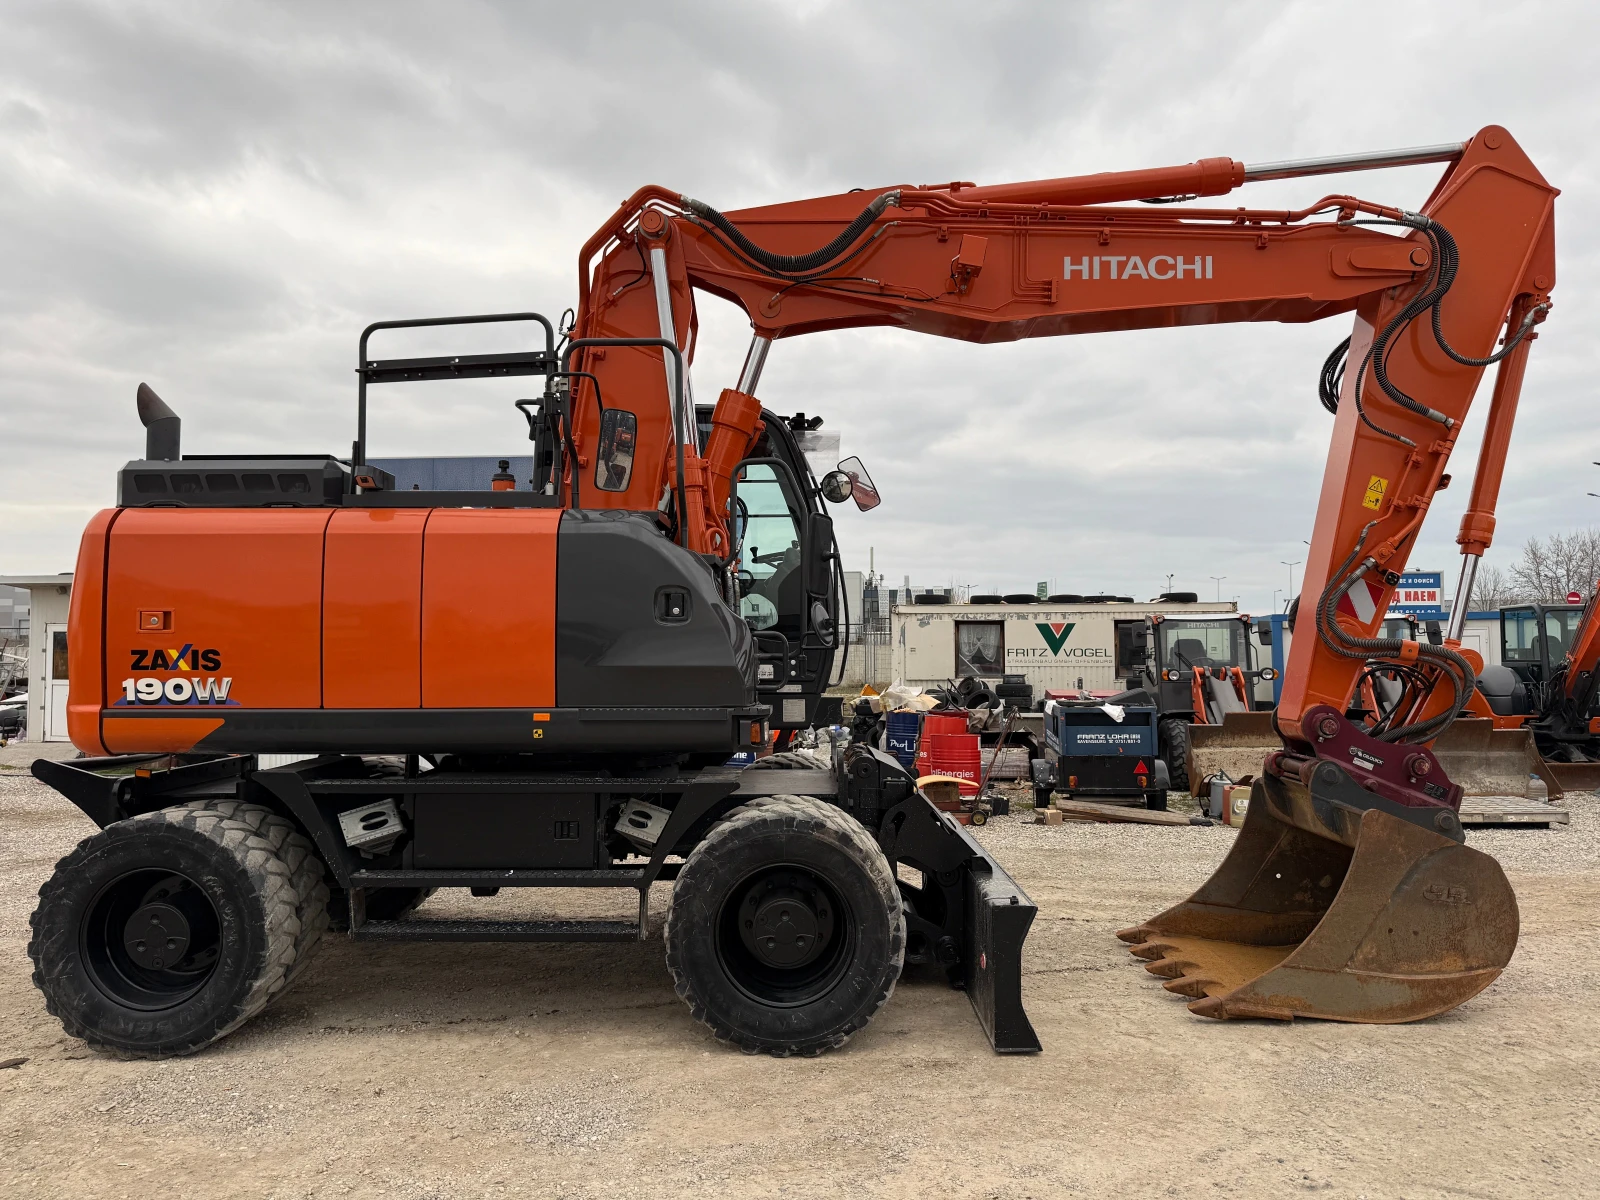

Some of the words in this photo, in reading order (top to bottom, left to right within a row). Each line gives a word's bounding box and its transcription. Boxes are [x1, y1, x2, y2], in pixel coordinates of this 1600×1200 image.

[1063, 255, 1213, 280] HITACHI
[1404, 591, 1436, 601] НАЕМ
[130, 644, 222, 671] ZAXIS
[1007, 648, 1048, 657] FRITZ
[1063, 648, 1113, 657] VOGEL
[122, 677, 233, 702] 190W
